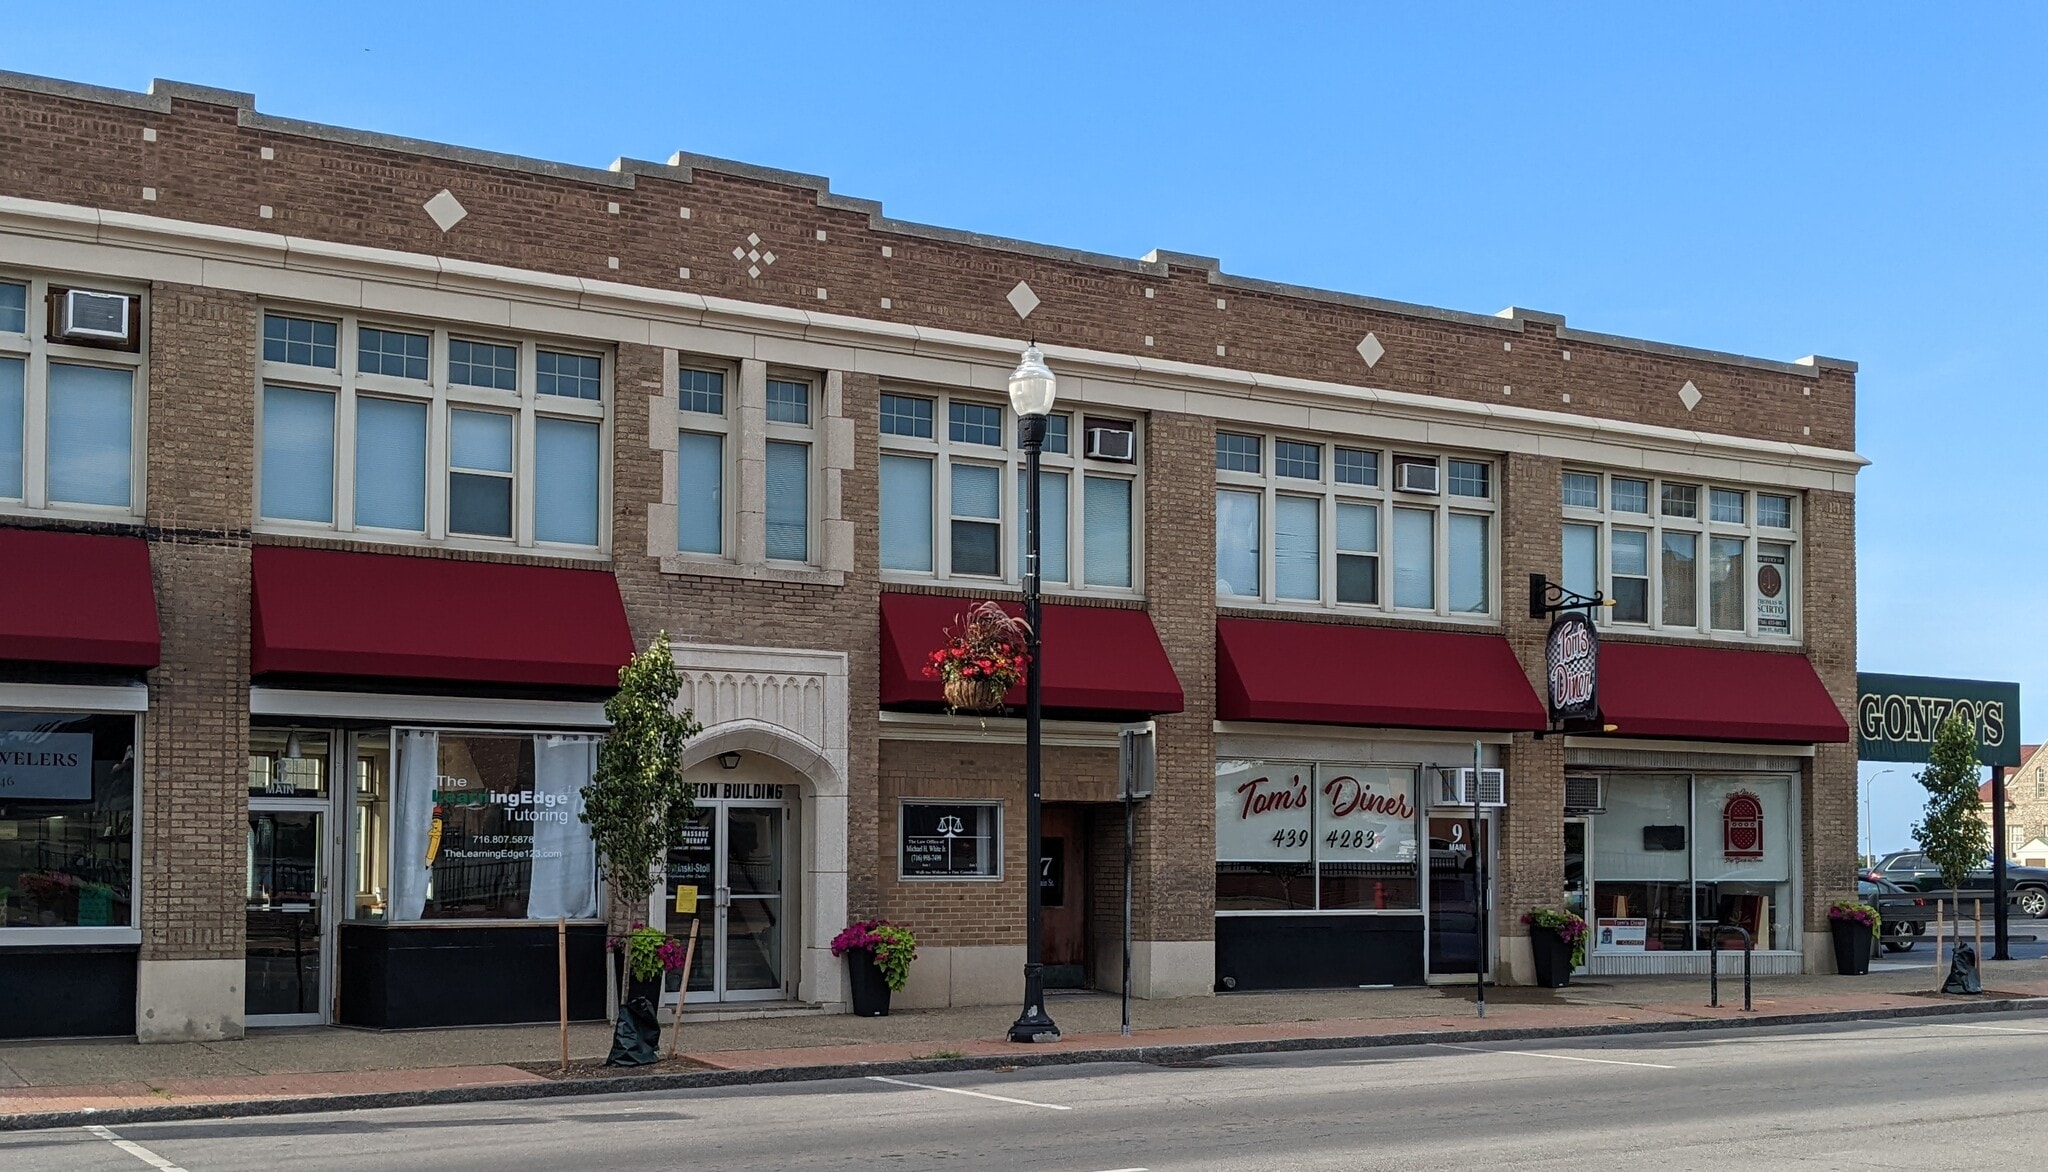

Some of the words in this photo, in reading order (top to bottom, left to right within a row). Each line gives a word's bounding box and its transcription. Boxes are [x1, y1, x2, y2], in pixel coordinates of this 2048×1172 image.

[1558, 621, 1589, 664] Tom's
[1550, 663, 1593, 709] Diner
[1858, 693, 2004, 747] GONZO'S
[0, 751, 78, 767] WELERS
[265, 784, 295, 794] MAIN
[436, 775, 468, 787] The
[432, 789, 568, 807] LearningEdge
[723, 784, 783, 799] BUILDING
[1238, 775, 1307, 819] Tom's
[1324, 776, 1413, 818] Diner
[504, 807, 568, 824] Tutoring
[473, 835, 535, 844] 716.807.5878
[1272, 828, 1309, 848] 439
[1326, 829, 1375, 848] 4283
[1452, 823, 1463, 844] 9
[444, 849, 562, 859] TheLearningEdge123.com
[1448, 843, 1467, 851] MAIN
